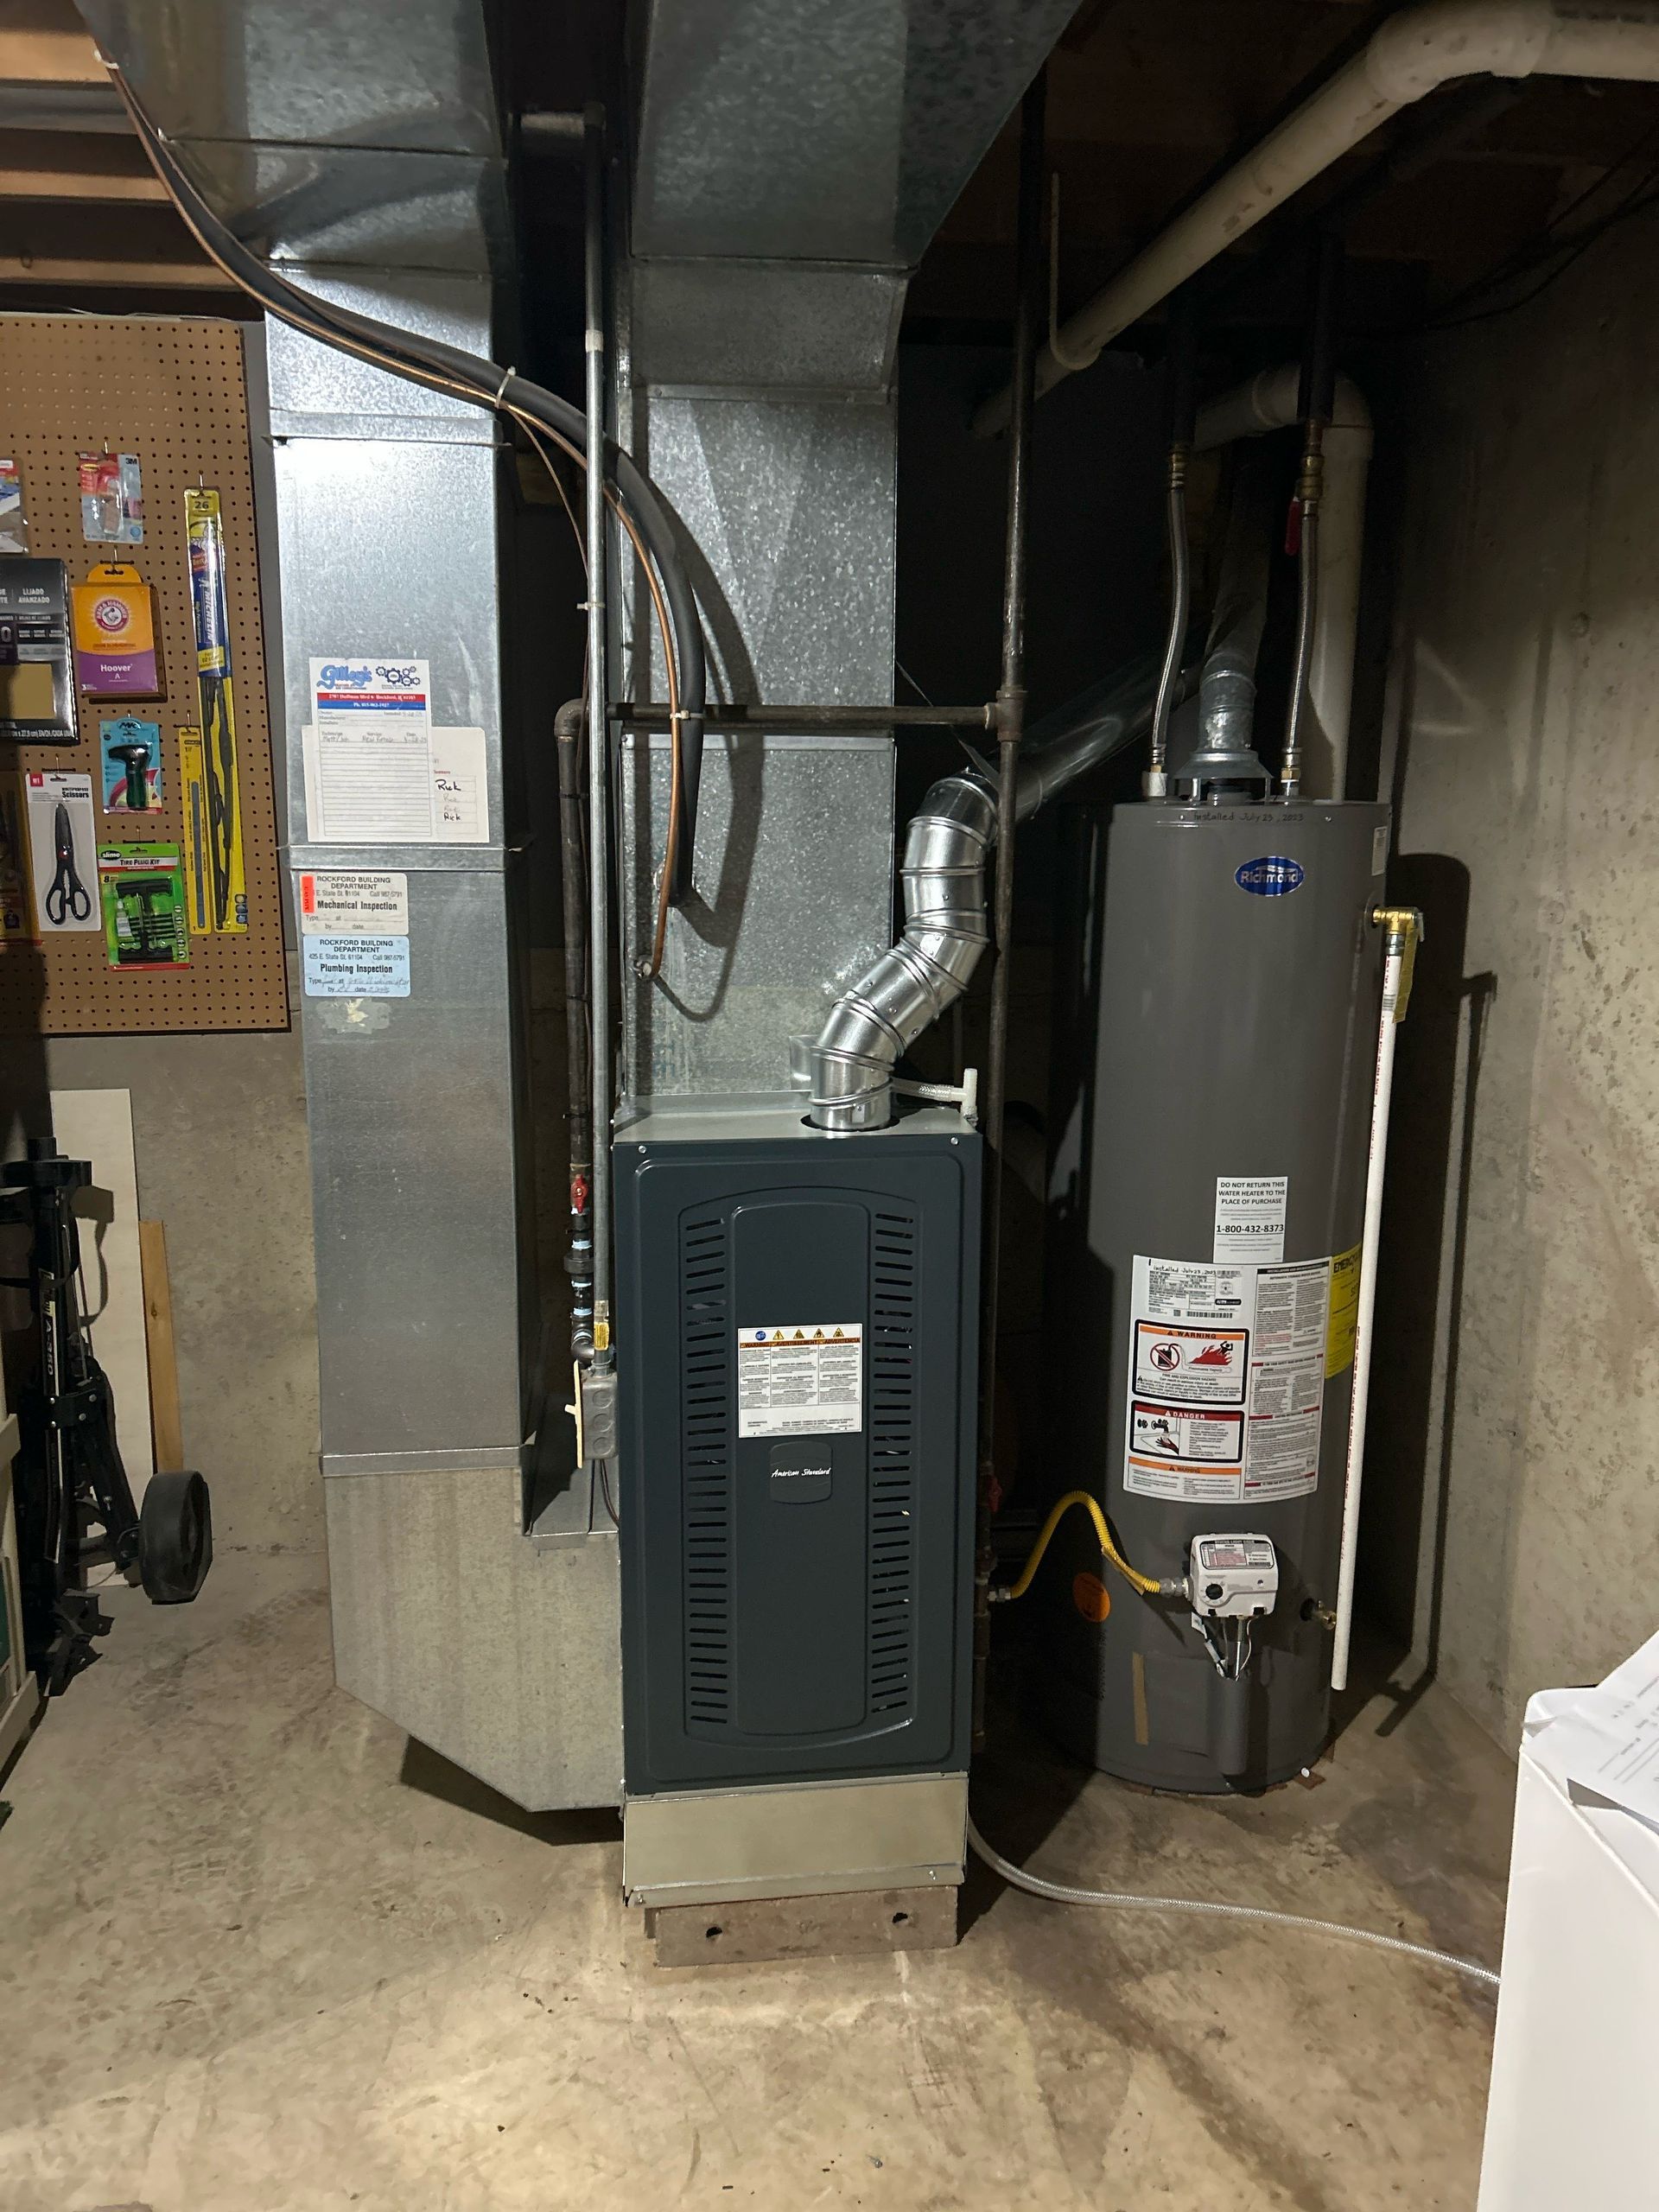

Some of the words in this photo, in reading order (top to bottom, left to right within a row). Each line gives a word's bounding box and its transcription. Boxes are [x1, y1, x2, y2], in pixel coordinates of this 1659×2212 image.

[444, 812, 461, 822] Rick
[1241, 868, 1299, 883] Richmond
[317, 900, 358, 909] Mechanical
[361, 900, 397, 911] Inspection
[306, 914, 318, 923] Type
[320, 963, 354, 975] Plumbing
[356, 964, 392, 975] Inspection
[1217, 1224, 1284, 1232] 1-800-432-8373
[771, 1469, 800, 1478] American
[801, 1467, 831, 1476] Standard
